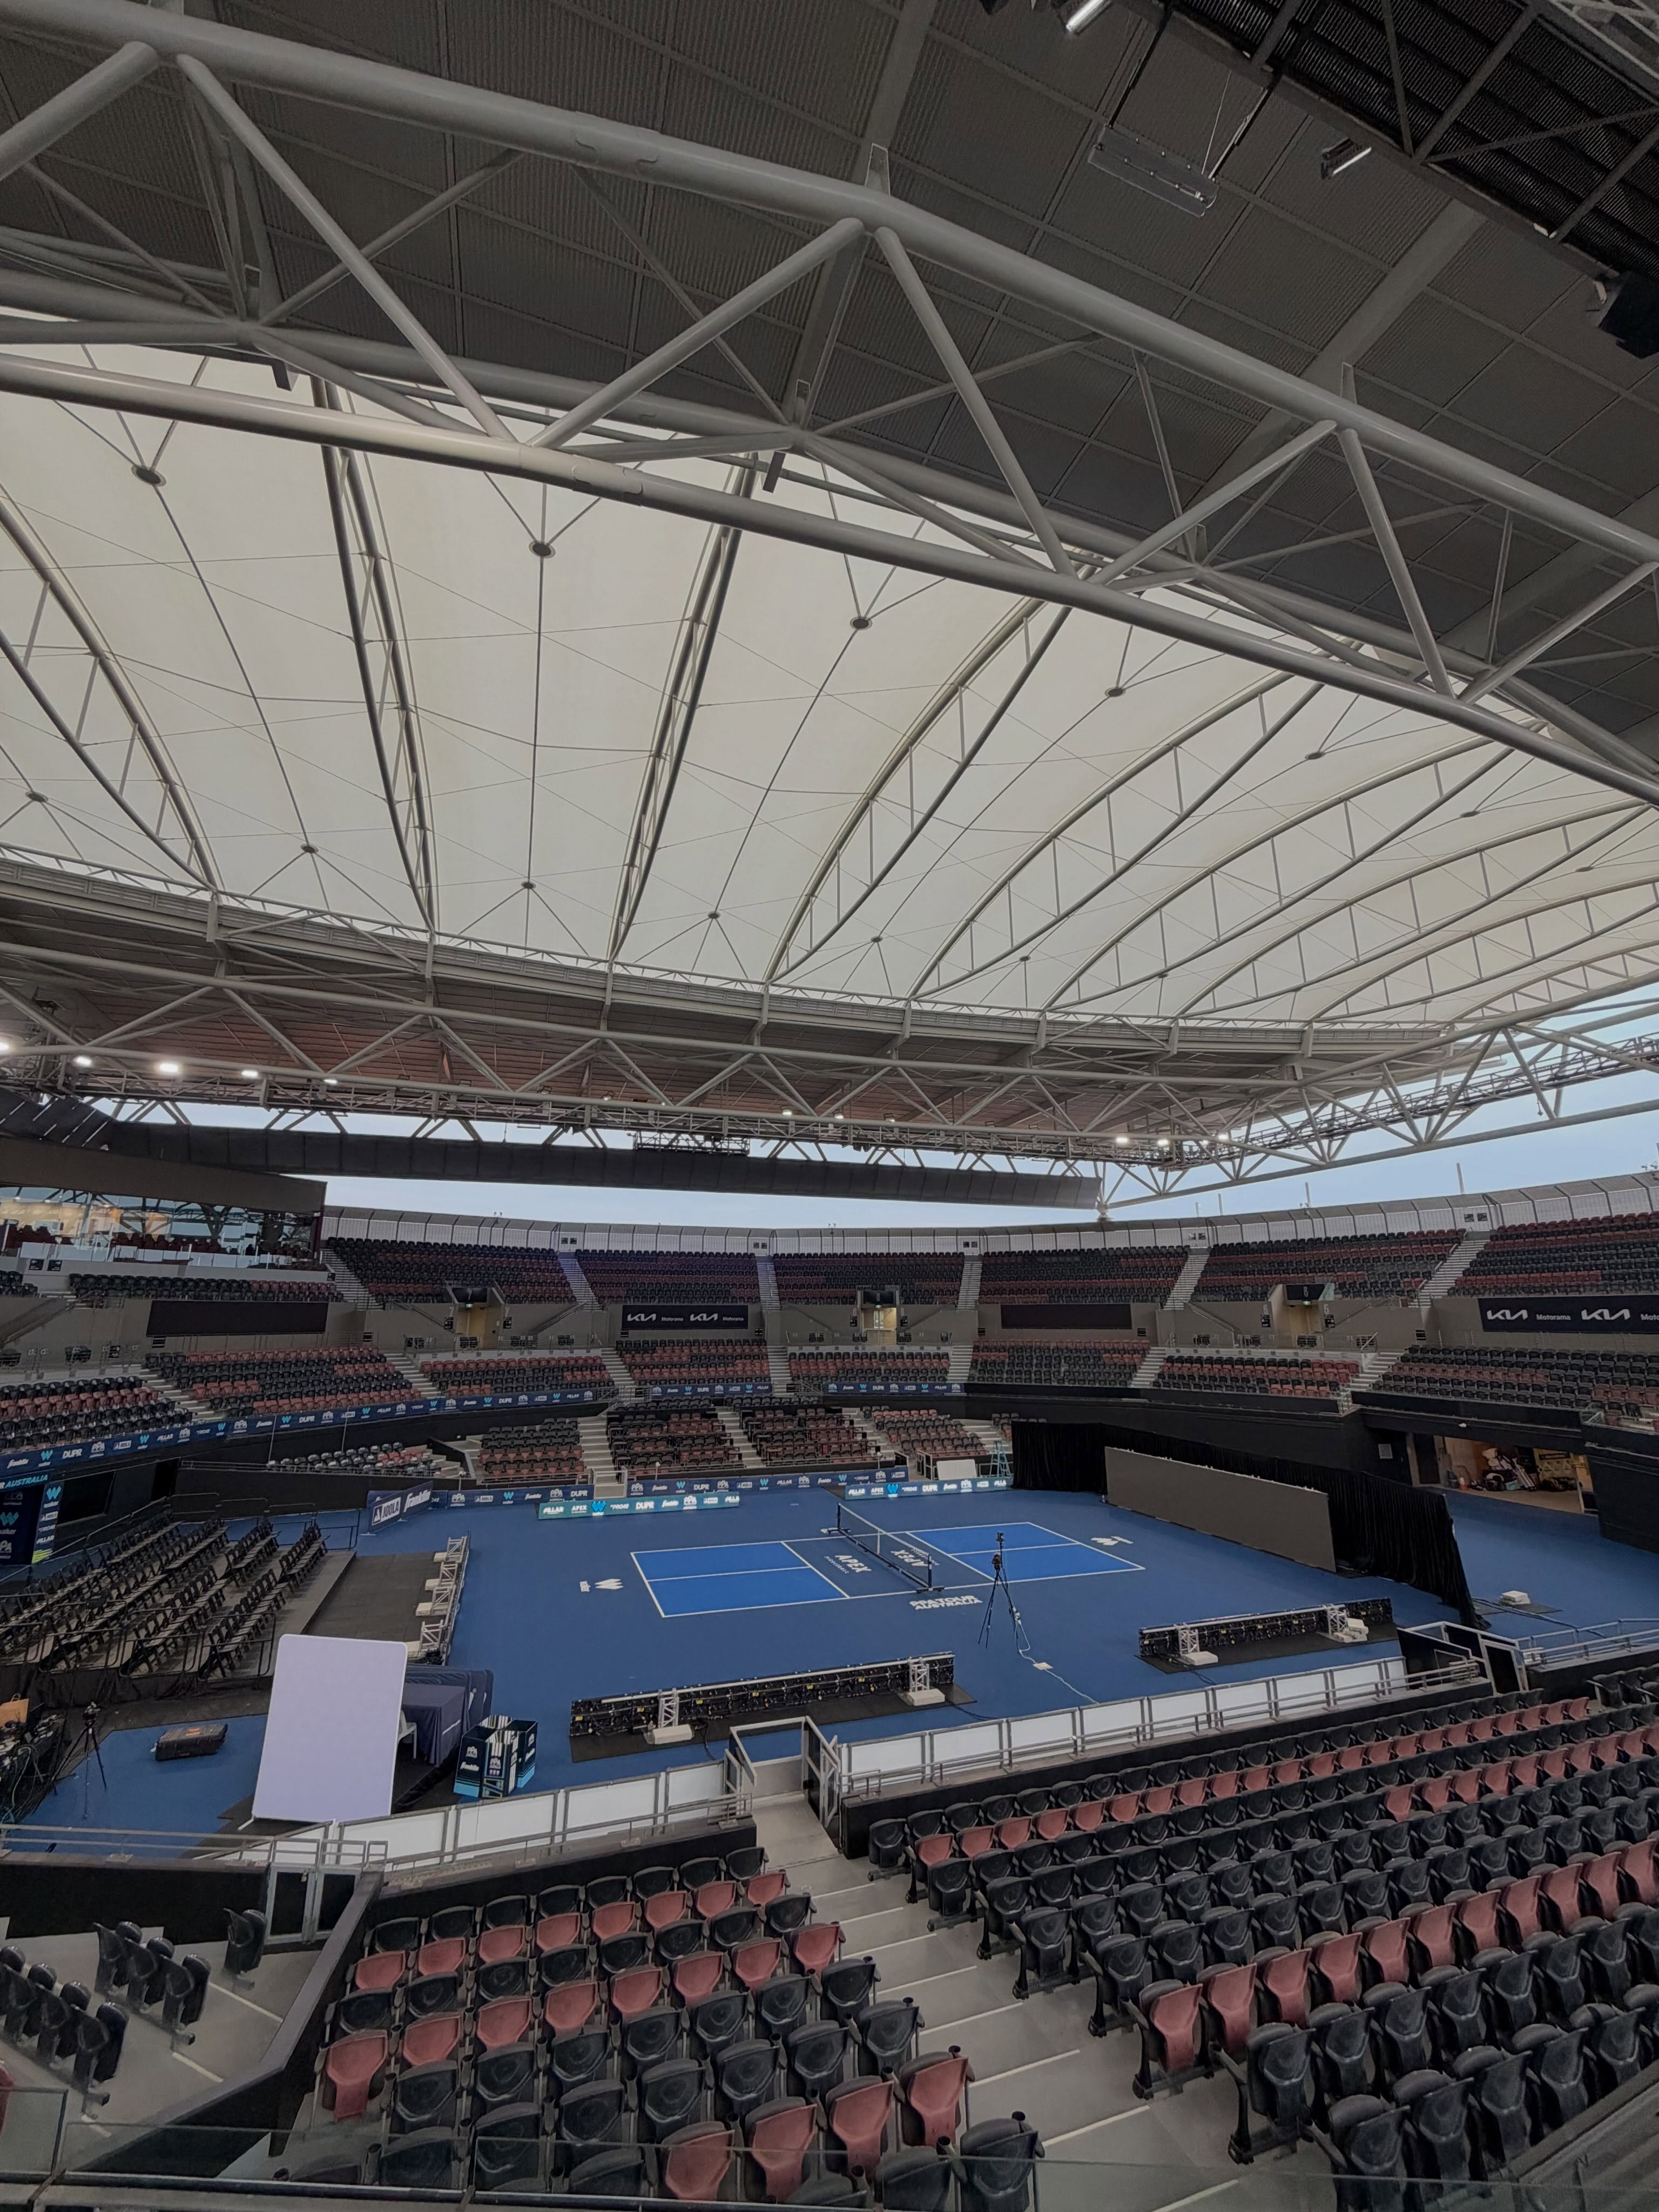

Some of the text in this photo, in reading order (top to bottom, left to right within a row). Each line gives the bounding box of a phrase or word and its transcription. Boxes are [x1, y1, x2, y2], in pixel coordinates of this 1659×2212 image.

[62, 1449, 82, 1459] DUPR
[5, 1475, 48, 1488] AUSTRALIA
[631, 1483, 643, 1491] PPA
[451, 1493, 465, 1502] PPA
[636, 1501, 654, 1509] DUPR
[382, 1503, 399, 1518] JOOLA
[890, 1549, 929, 1567] APEX
[834, 1555, 872, 1573] APEX
[915, 1599, 983, 1610] AUSTRALIA
[935, 1595, 977, 1604] TOUR
